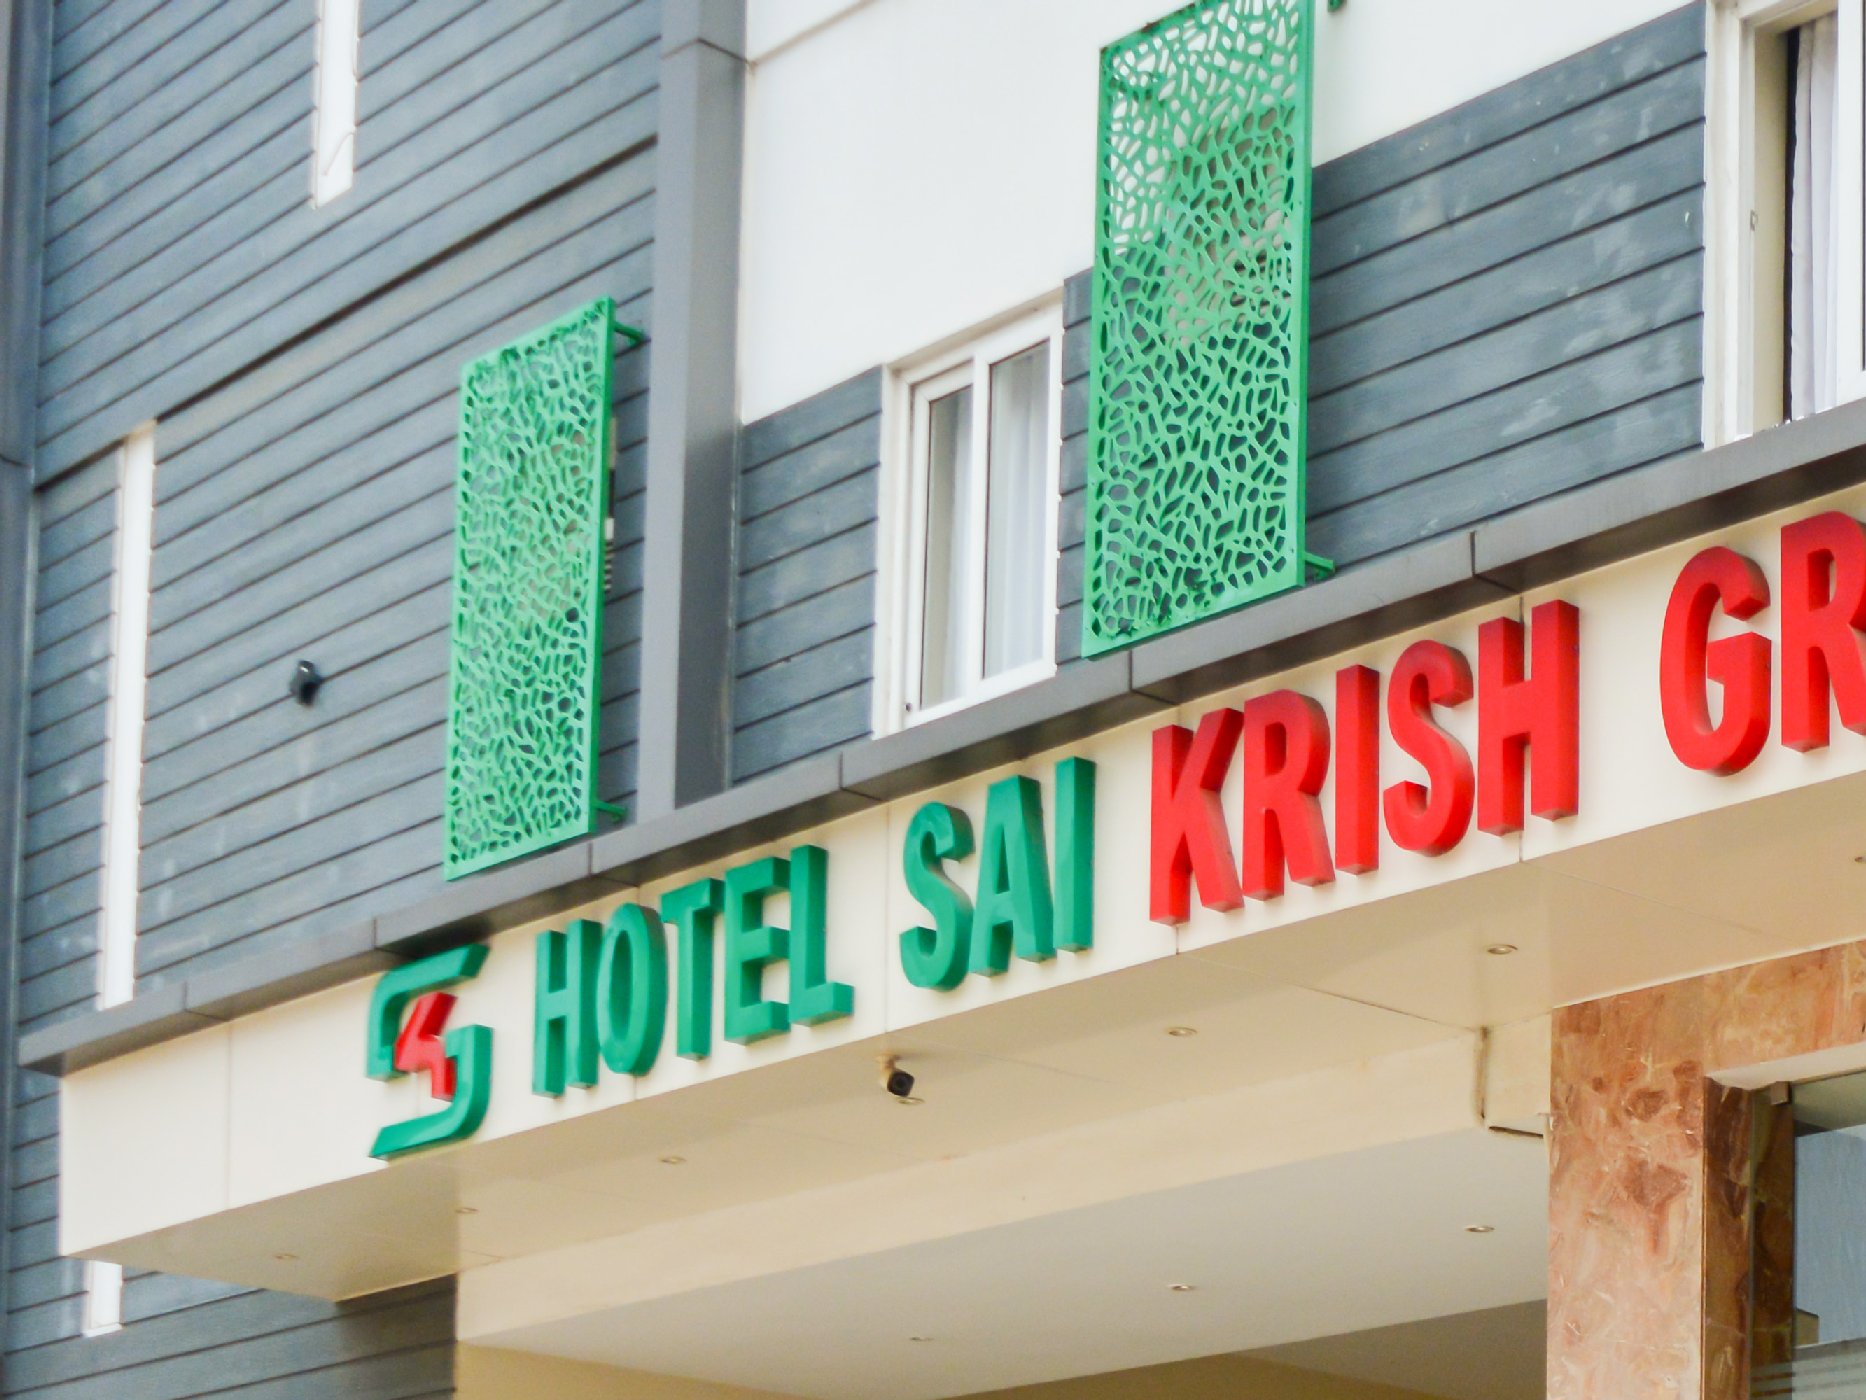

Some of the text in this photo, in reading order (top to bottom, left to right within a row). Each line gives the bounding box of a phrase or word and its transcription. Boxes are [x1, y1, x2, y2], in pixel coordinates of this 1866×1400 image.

[534, 845, 854, 1096] HOTEL
[899, 756, 1096, 990] SAI
[1149, 599, 1580, 926] KRISH
